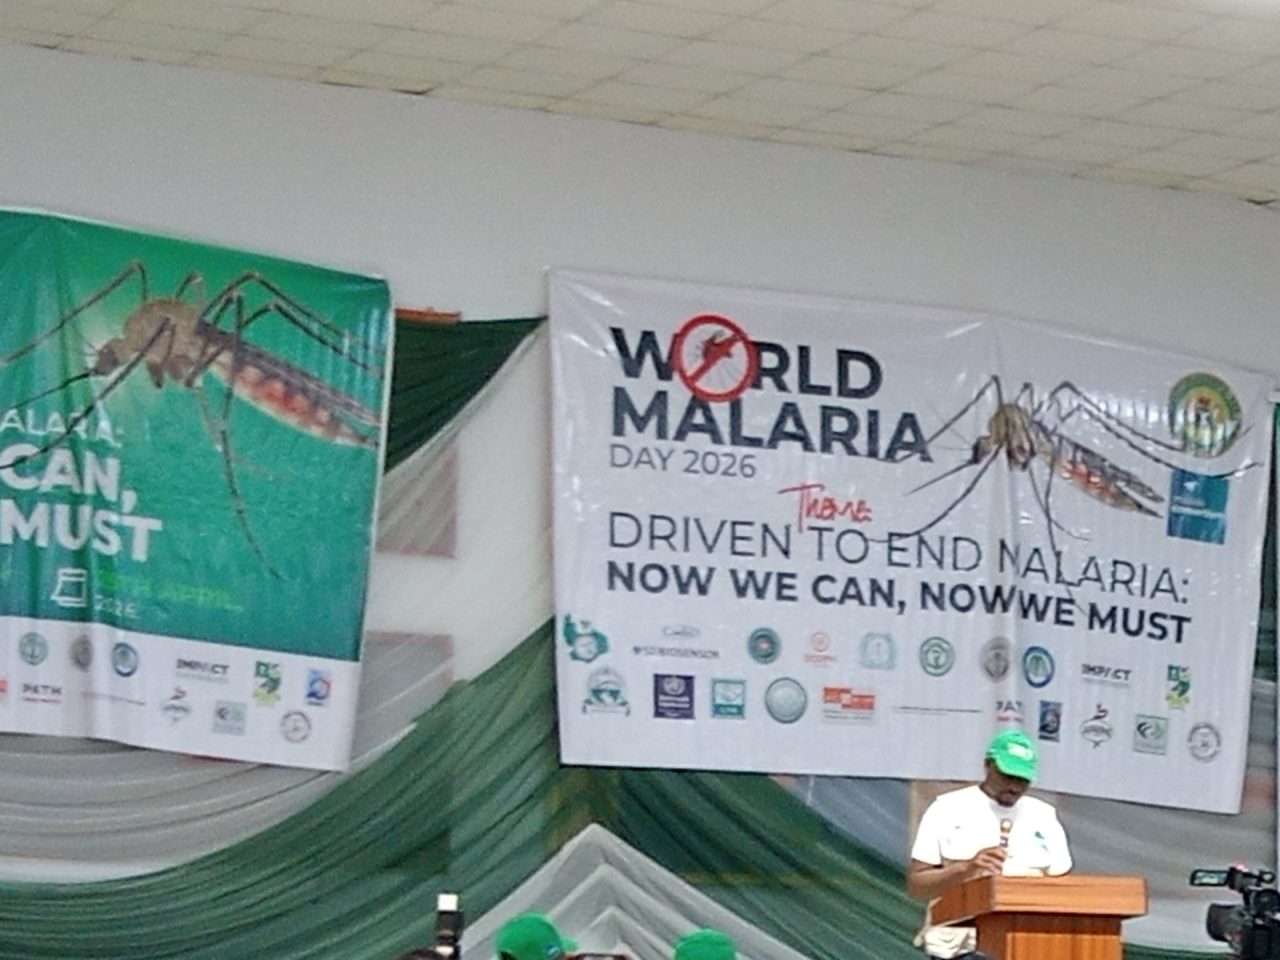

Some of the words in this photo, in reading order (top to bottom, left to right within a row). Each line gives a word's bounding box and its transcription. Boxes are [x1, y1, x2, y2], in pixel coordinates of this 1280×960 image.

[612, 385, 934, 463] MALARIA
[0, 443, 138, 513] CAN,
[610, 443, 675, 471] DAY
[683, 449, 757, 478] 2026
[0, 499, 163, 562] MUST
[609, 511, 791, 560] DRIVEN
[807, 525, 870, 565] TO
[887, 531, 983, 573] END
[607, 560, 716, 597] NOW
[729, 567, 798, 602] WE
[811, 574, 907, 616] CAN,
[920, 580, 1016, 615] NOW
[1019, 591, 1076, 627] WE
[1087, 602, 1192, 644] MUST
